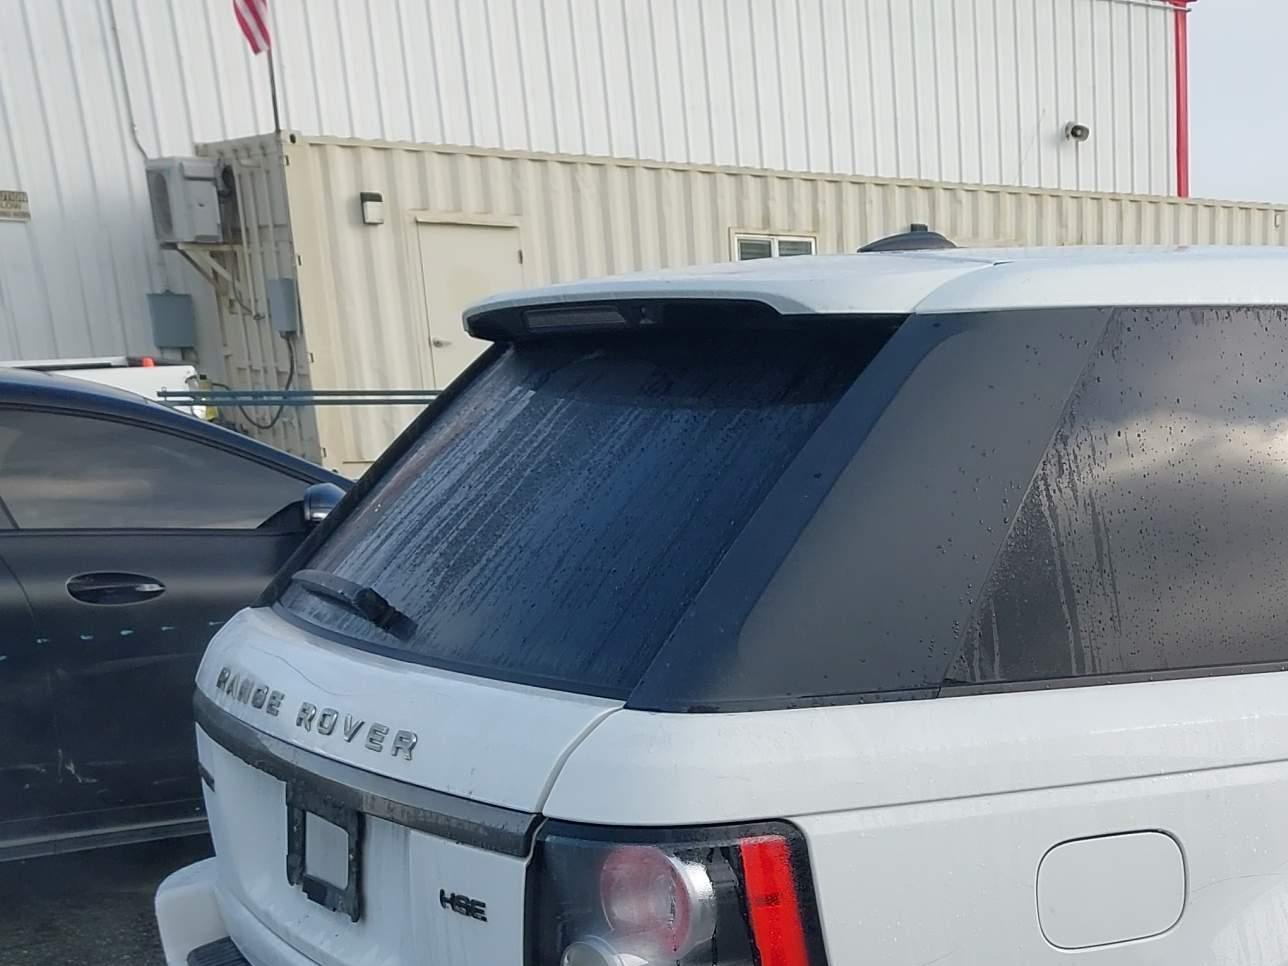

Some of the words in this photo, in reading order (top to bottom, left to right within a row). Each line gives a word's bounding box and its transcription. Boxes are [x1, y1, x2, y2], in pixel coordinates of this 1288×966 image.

[216, 667, 285, 716] RANGE
[296, 702, 418, 761] ROVER
[440, 889, 487, 922] HSE
